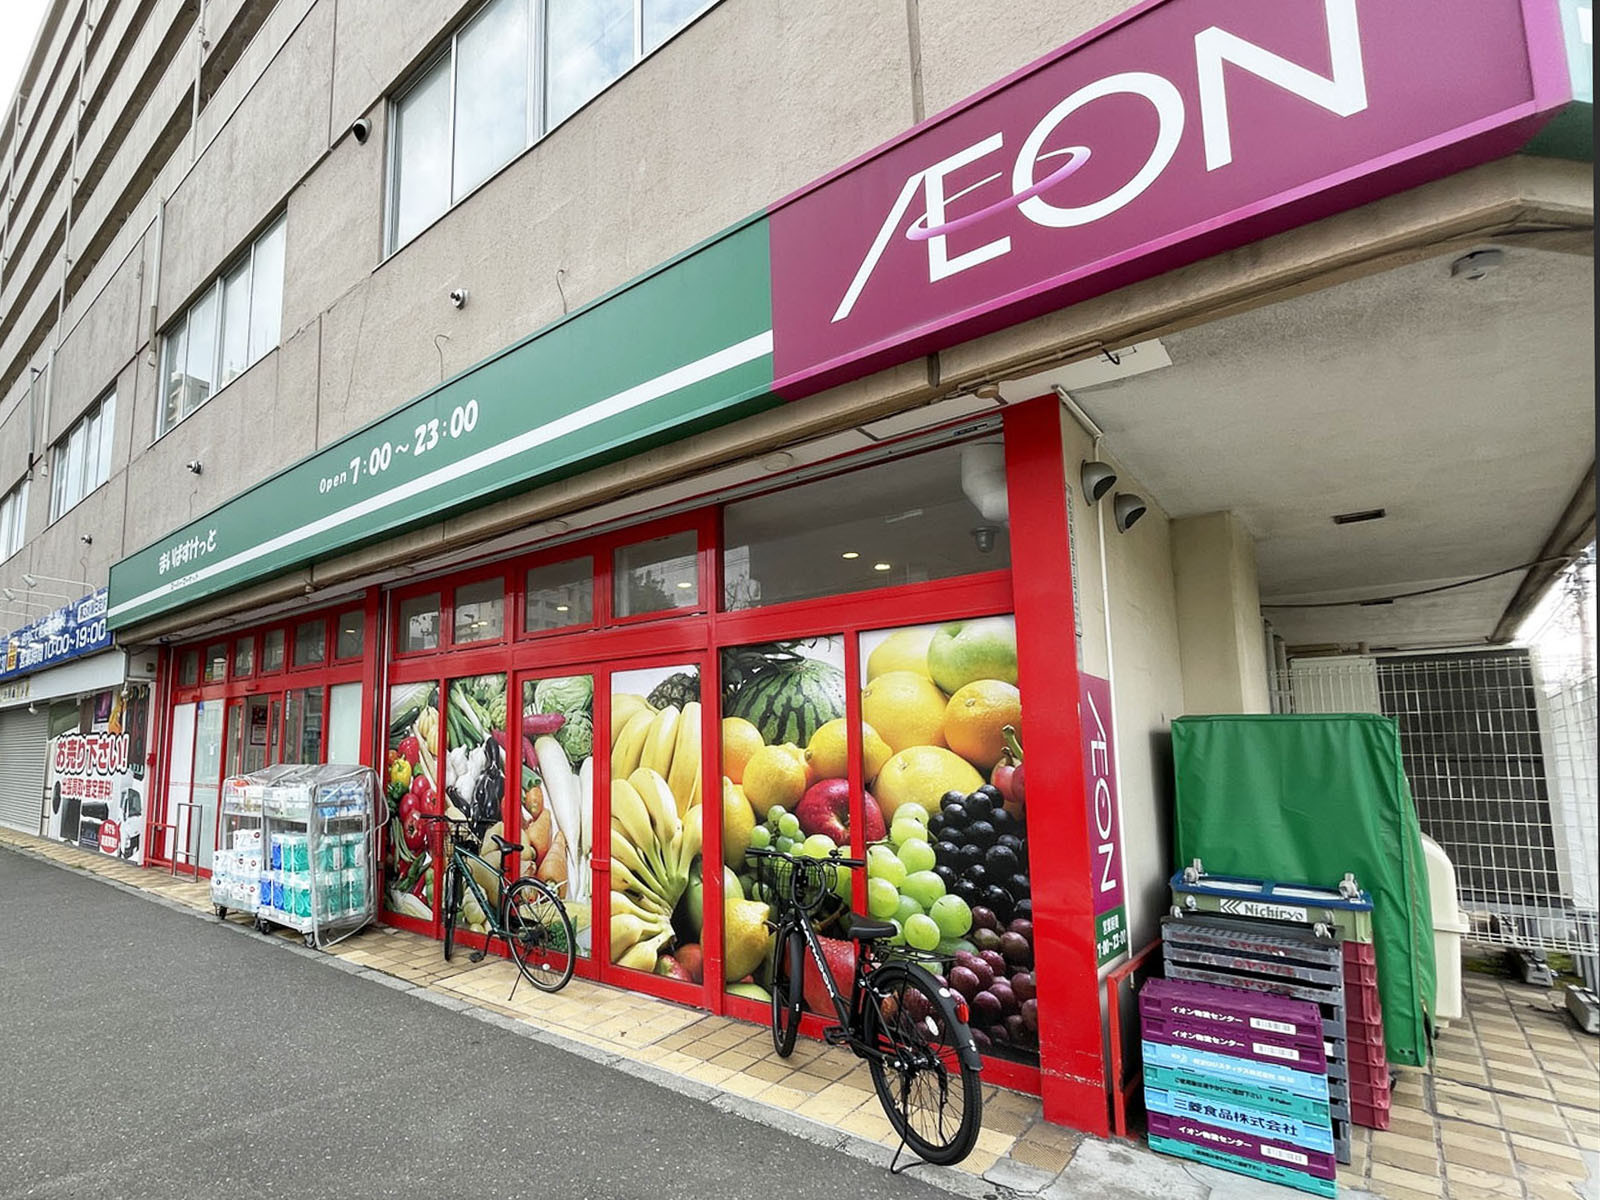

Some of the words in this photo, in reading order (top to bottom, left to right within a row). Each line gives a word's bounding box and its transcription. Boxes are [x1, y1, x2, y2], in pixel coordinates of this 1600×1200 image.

[319, 470, 348, 494] Open
[1244, 902, 1304, 921] Nichiryo
[1170, 1005, 1244, 1024] イオン物流センター
[1171, 1029, 1246, 1049] イオン物流センター
[1178, 1125, 1253, 1149] イオン物流センター
